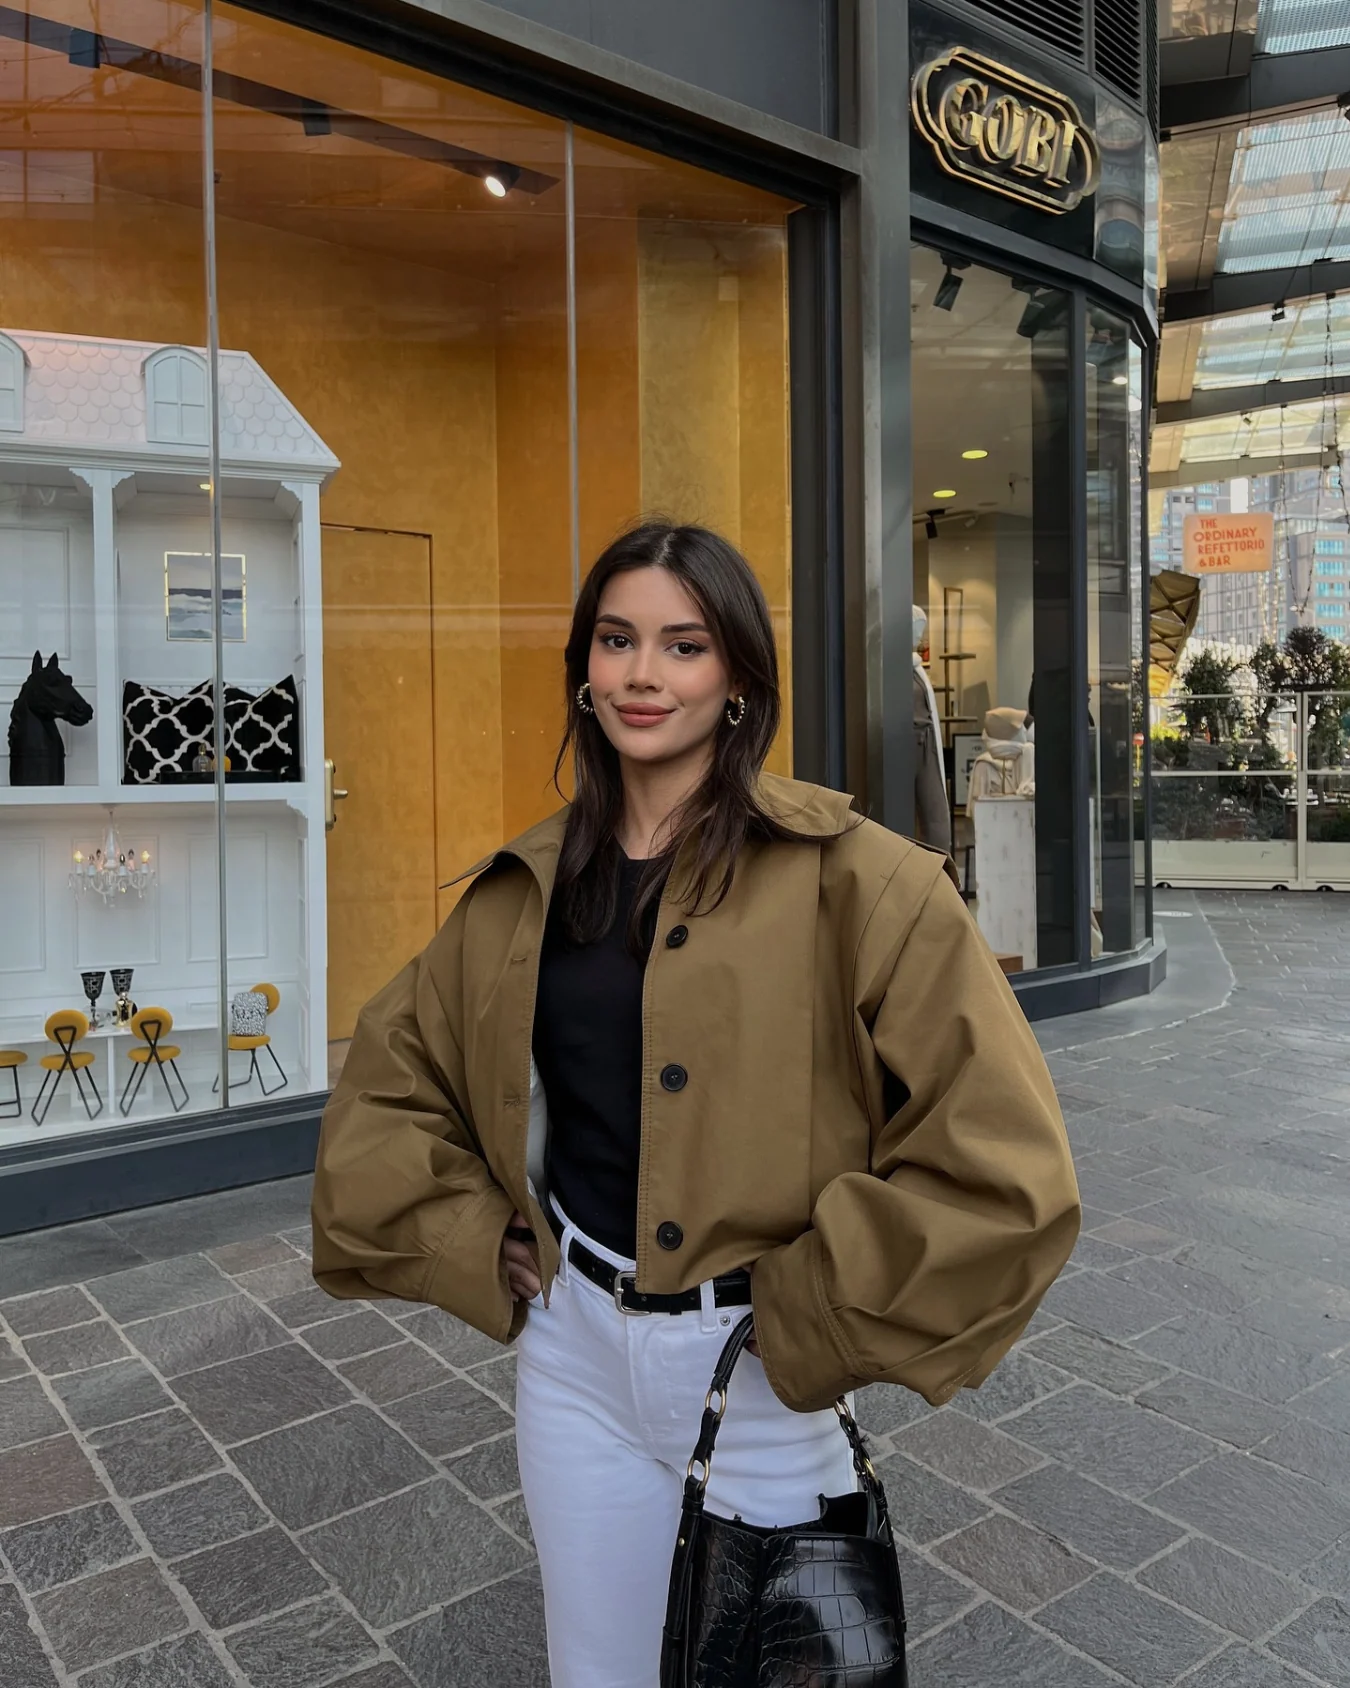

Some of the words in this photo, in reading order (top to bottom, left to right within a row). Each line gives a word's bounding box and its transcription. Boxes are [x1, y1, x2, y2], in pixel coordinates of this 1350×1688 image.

[940, 78, 1079, 188] GOBI
[1200, 519, 1217, 528] THE
[1193, 527, 1257, 542] ORDINARY
[1198, 539, 1265, 554] REFETTORIO
[1199, 558, 1206, 567] &
[1208, 555, 1231, 567] BAR
